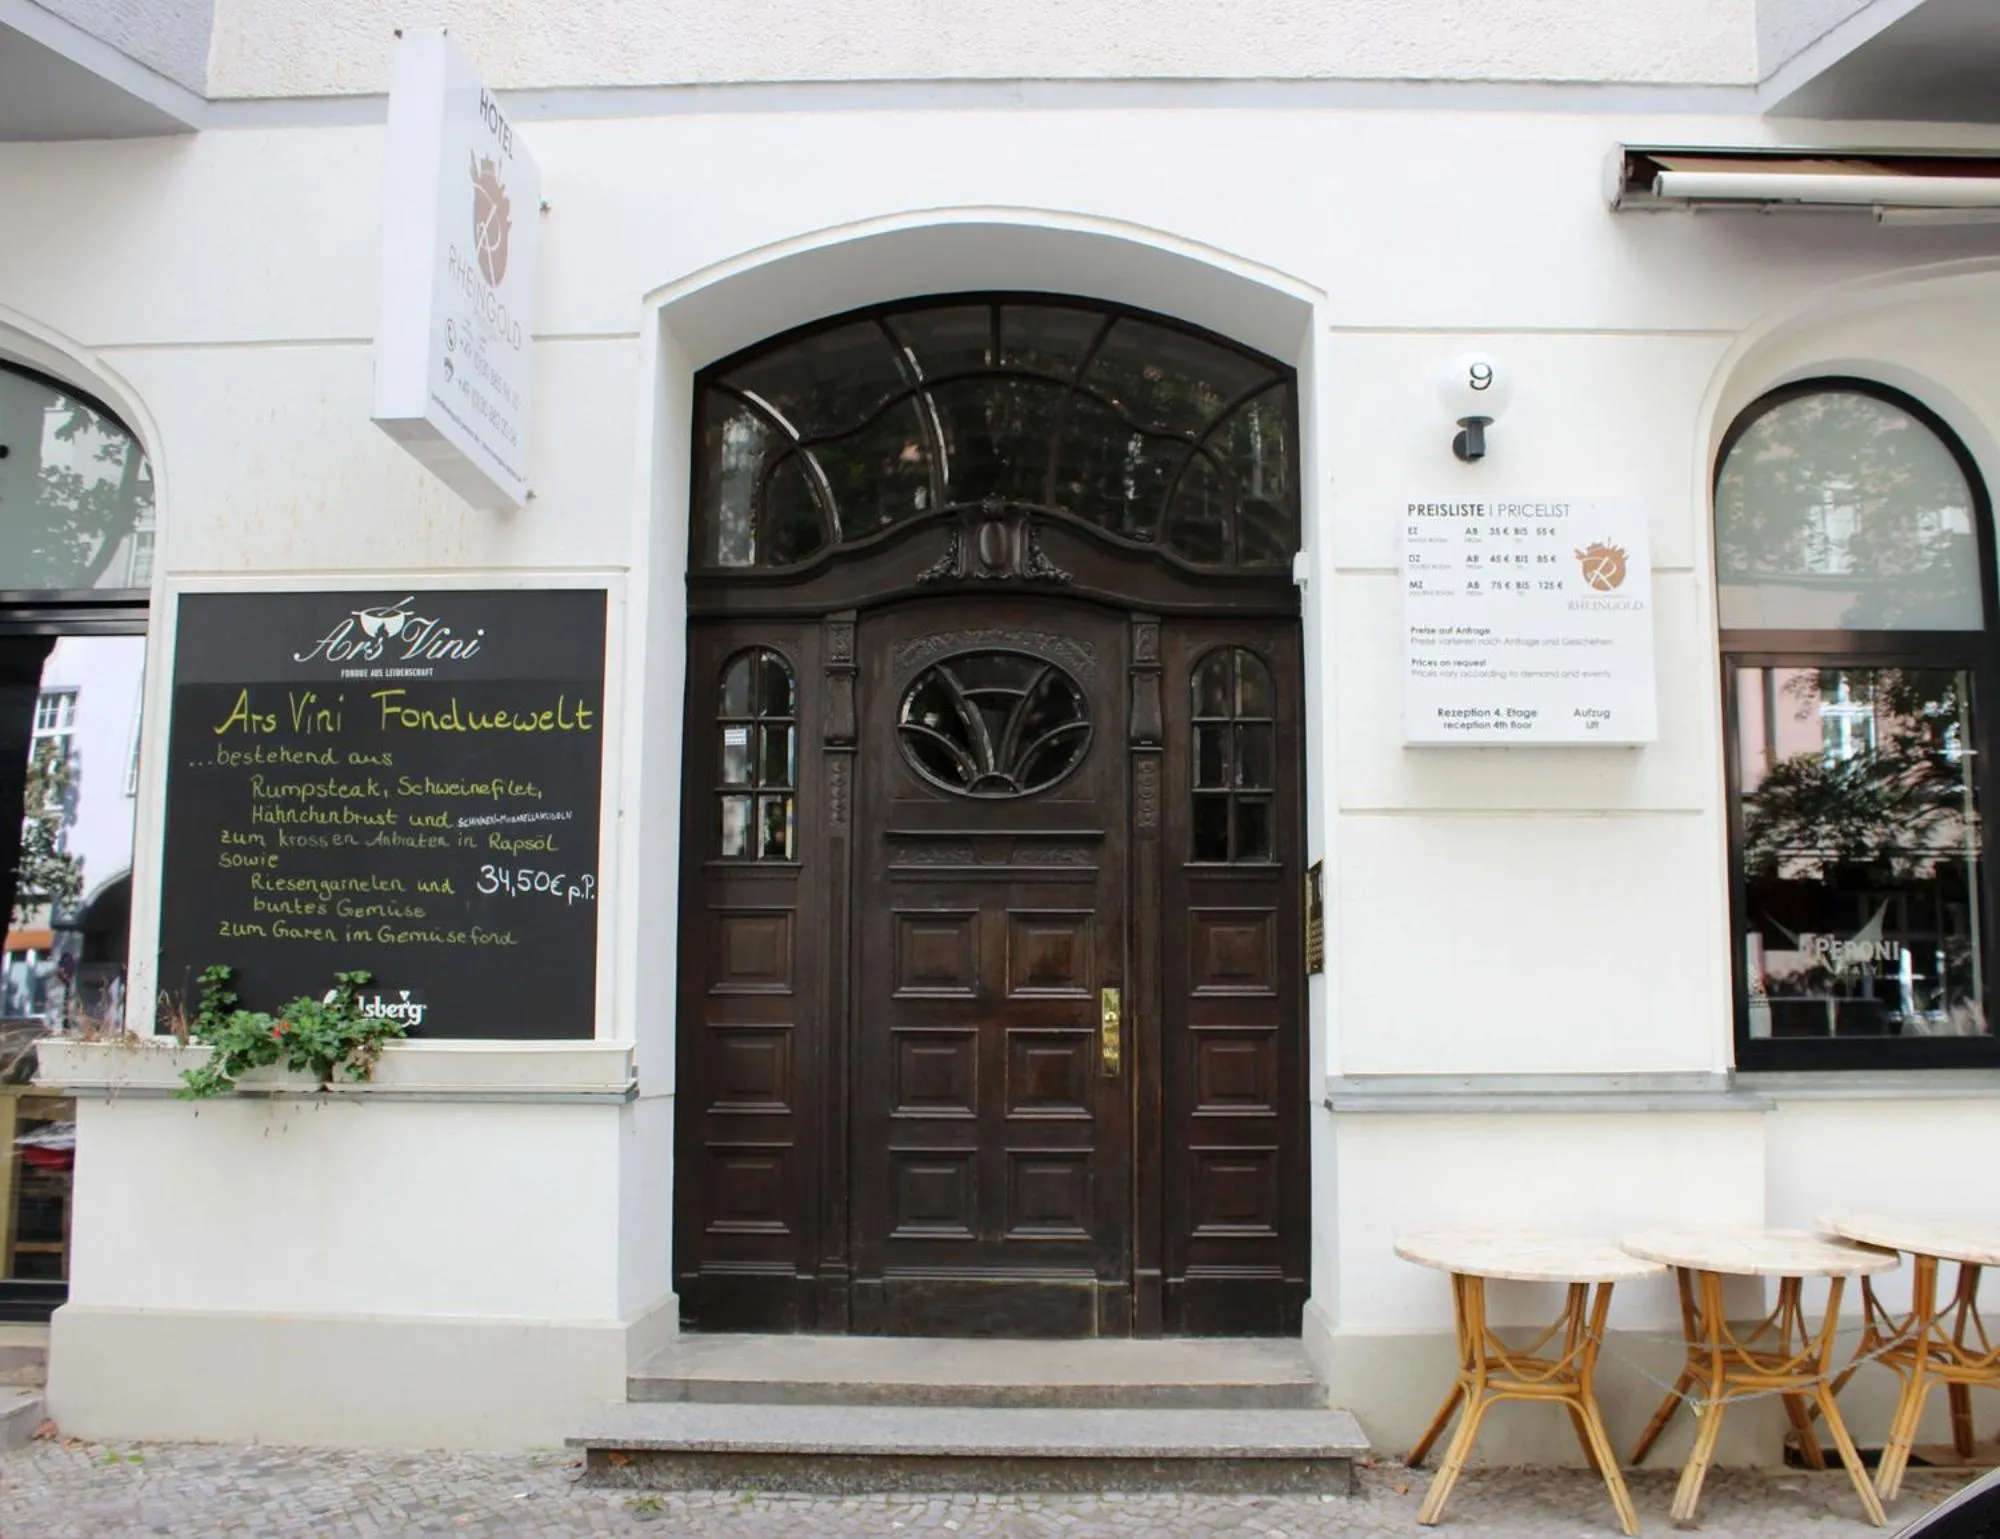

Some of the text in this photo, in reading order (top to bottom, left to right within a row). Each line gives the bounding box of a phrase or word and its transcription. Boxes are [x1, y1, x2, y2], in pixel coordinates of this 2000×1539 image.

[479, 87, 514, 161] HOTEL
[448, 245, 521, 351] RHEINGOLD
[1470, 362, 1492, 391] 9
[1408, 504, 1485, 517] PREISLISTE
[1498, 503, 1570, 518] PRICELIST
[1408, 527, 1418, 536] EZ
[1465, 527, 1478, 536] AB
[1503, 527, 1509, 536] €
[1514, 527, 1528, 536] BIS
[1549, 527, 1556, 536] €
[1408, 554, 1420, 563] DZ
[1466, 554, 1479, 563] AB
[1489, 554, 1501, 563] 45
[1503, 554, 1509, 563] €
[1515, 554, 1529, 563] BIS
[1549, 554, 1557, 563] €
[1409, 581, 1423, 590] MZ
[1467, 581, 1480, 590] AB
[1505, 581, 1511, 590] €
[1516, 581, 1530, 590] BIS
[1556, 581, 1564, 590] €
[1568, 601, 1644, 611] RHEINGOLD
[294, 617, 484, 662] Ars Vini
[1411, 627, 1490, 636] Preise auf Anfrage
[1503, 637, 1539, 647] Anfrage
[1541, 637, 1560, 646] und
[1411, 659, 1486, 668] Prices on request
[341, 667, 434, 678] FONDUE AUS LEIDENSCHAFT
[1411, 670, 1437, 678] Prices
[1439, 670, 1457, 679] vary
[1460, 670, 1507, 679] according
[1509, 670, 1518, 678] to
[1520, 670, 1560, 678] demand
[1561, 670, 1579, 678] and
[214, 688, 594, 735] Ars Vini Fonduewelt
[1437, 708, 1491, 718] Rezeption
[1507, 708, 1538, 719] Etage
[1574, 708, 1611, 720] Aufzug
[1443, 720, 1533, 730] reception 4th floor
[348, 751, 394, 767] aus
[250, 773, 543, 803] Rumpsteak, Schweinefilet,
[251, 804, 399, 826] Hähnchenbrust
[409, 807, 454, 829] und
[221, 829, 267, 848] zum
[278, 827, 358, 848] krossen
[458, 832, 478, 848] in
[489, 831, 561, 857] Rapsöl
[218, 852, 279, 869] sowie
[251, 872, 456, 902] Riesengarnelen und
[476, 864, 596, 906] 34,50€ p.P.
[253, 896, 427, 919] buntes Gemüse
[219, 921, 268, 938] zum
[272, 919, 339, 943] Garen
[346, 925, 373, 942] im
[1815, 938, 1899, 961] PERONI
[323, 989, 424, 1028] lsberg
